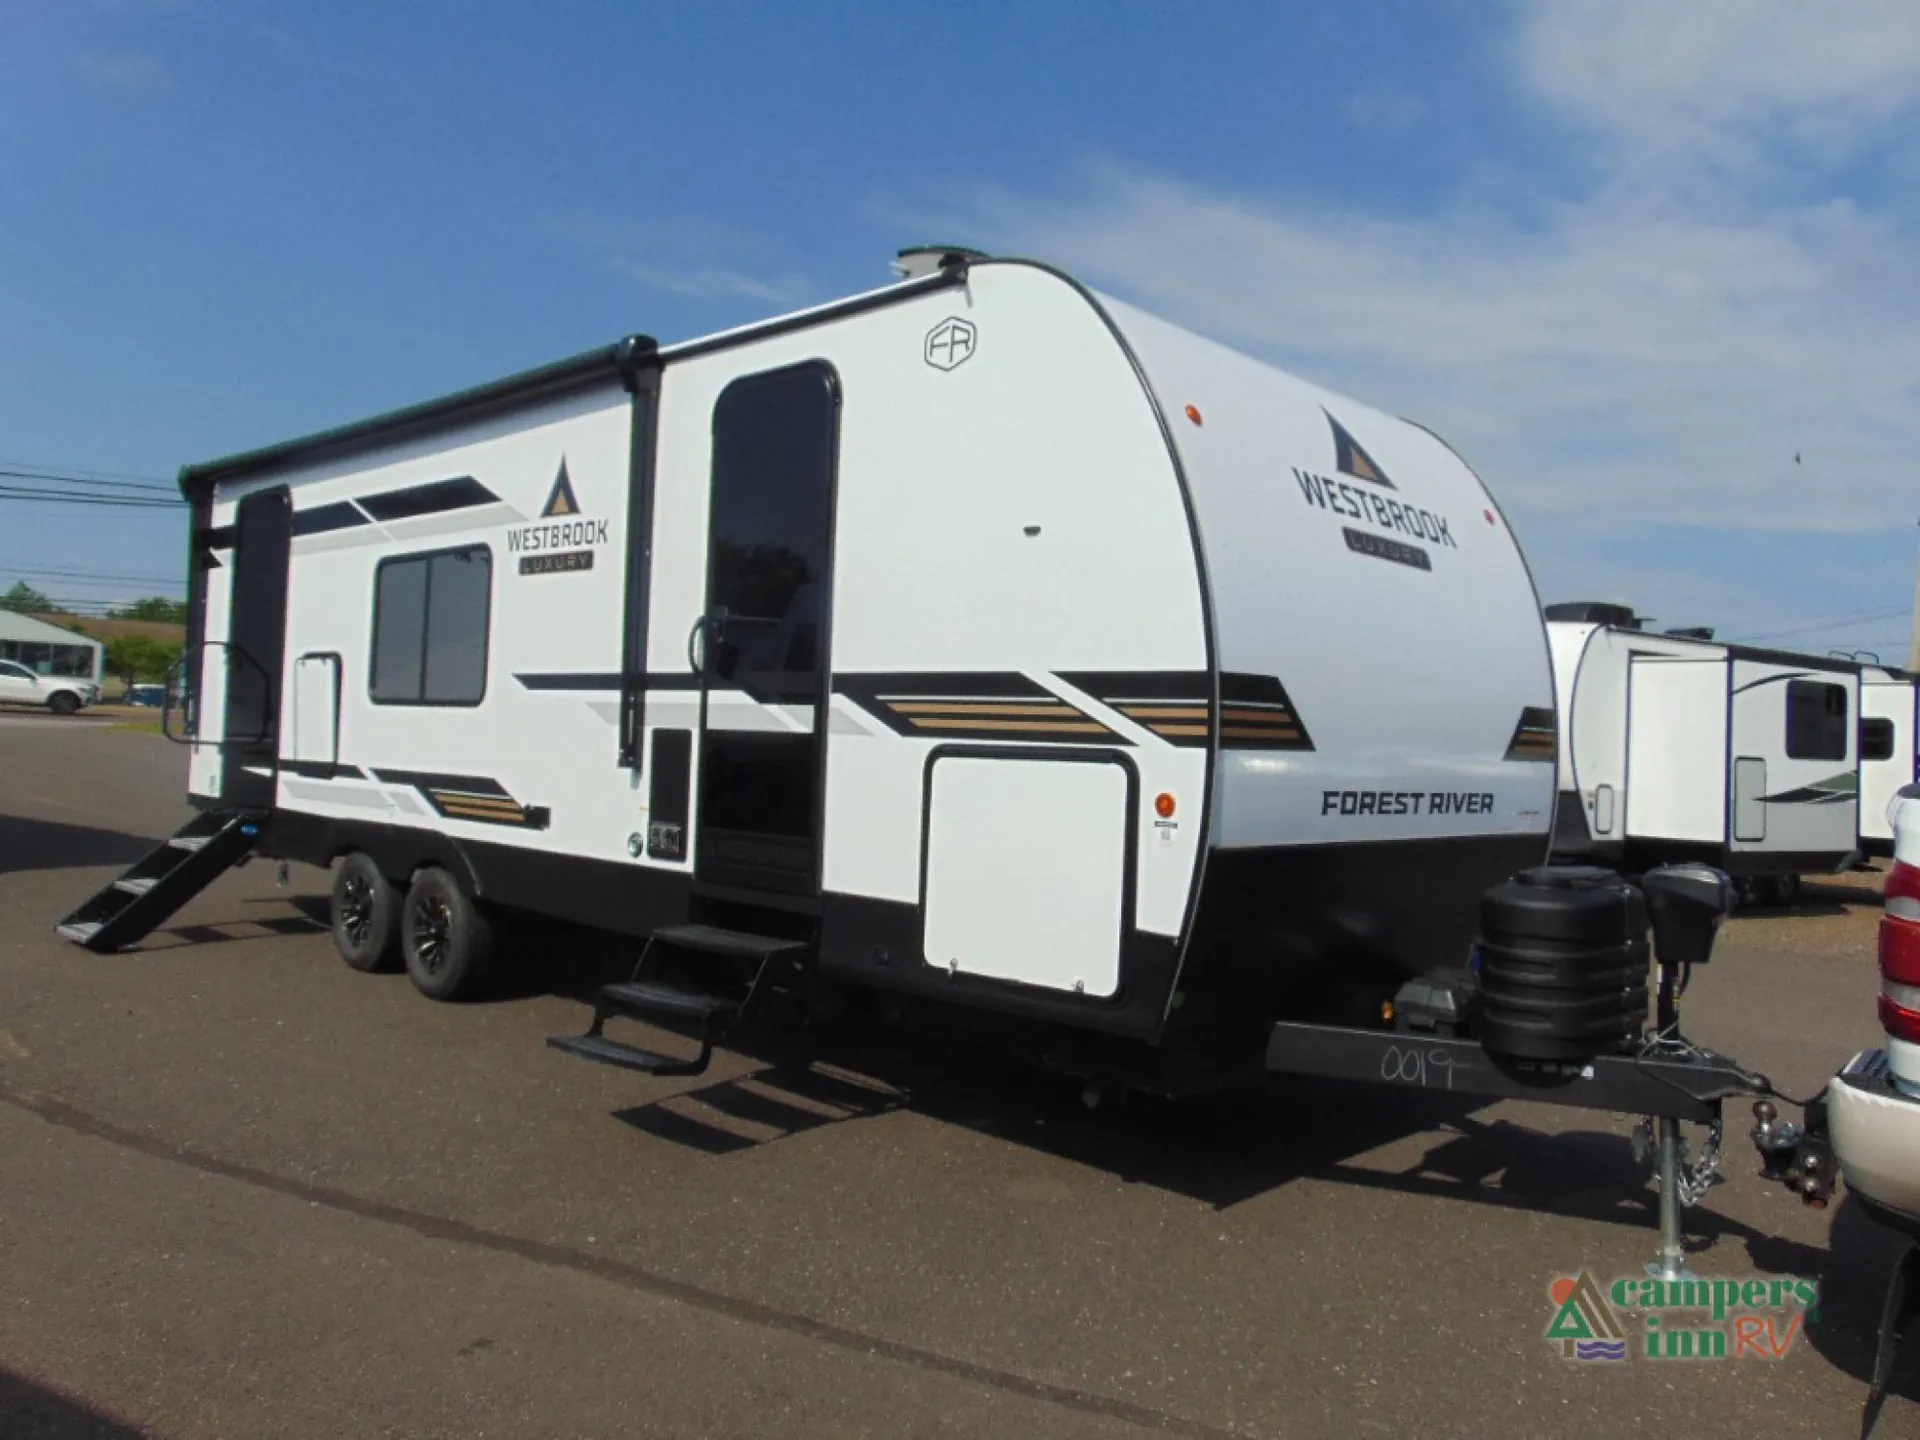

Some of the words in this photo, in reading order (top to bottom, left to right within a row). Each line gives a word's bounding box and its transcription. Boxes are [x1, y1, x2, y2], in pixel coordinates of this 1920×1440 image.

[1291, 466, 1458, 549] WESTBROOK
[507, 519, 609, 552] WESTBROOK
[521, 554, 589, 571] LUXURY
[1321, 791, 1424, 815] FOREST
[1429, 792, 1494, 814] RIVER
